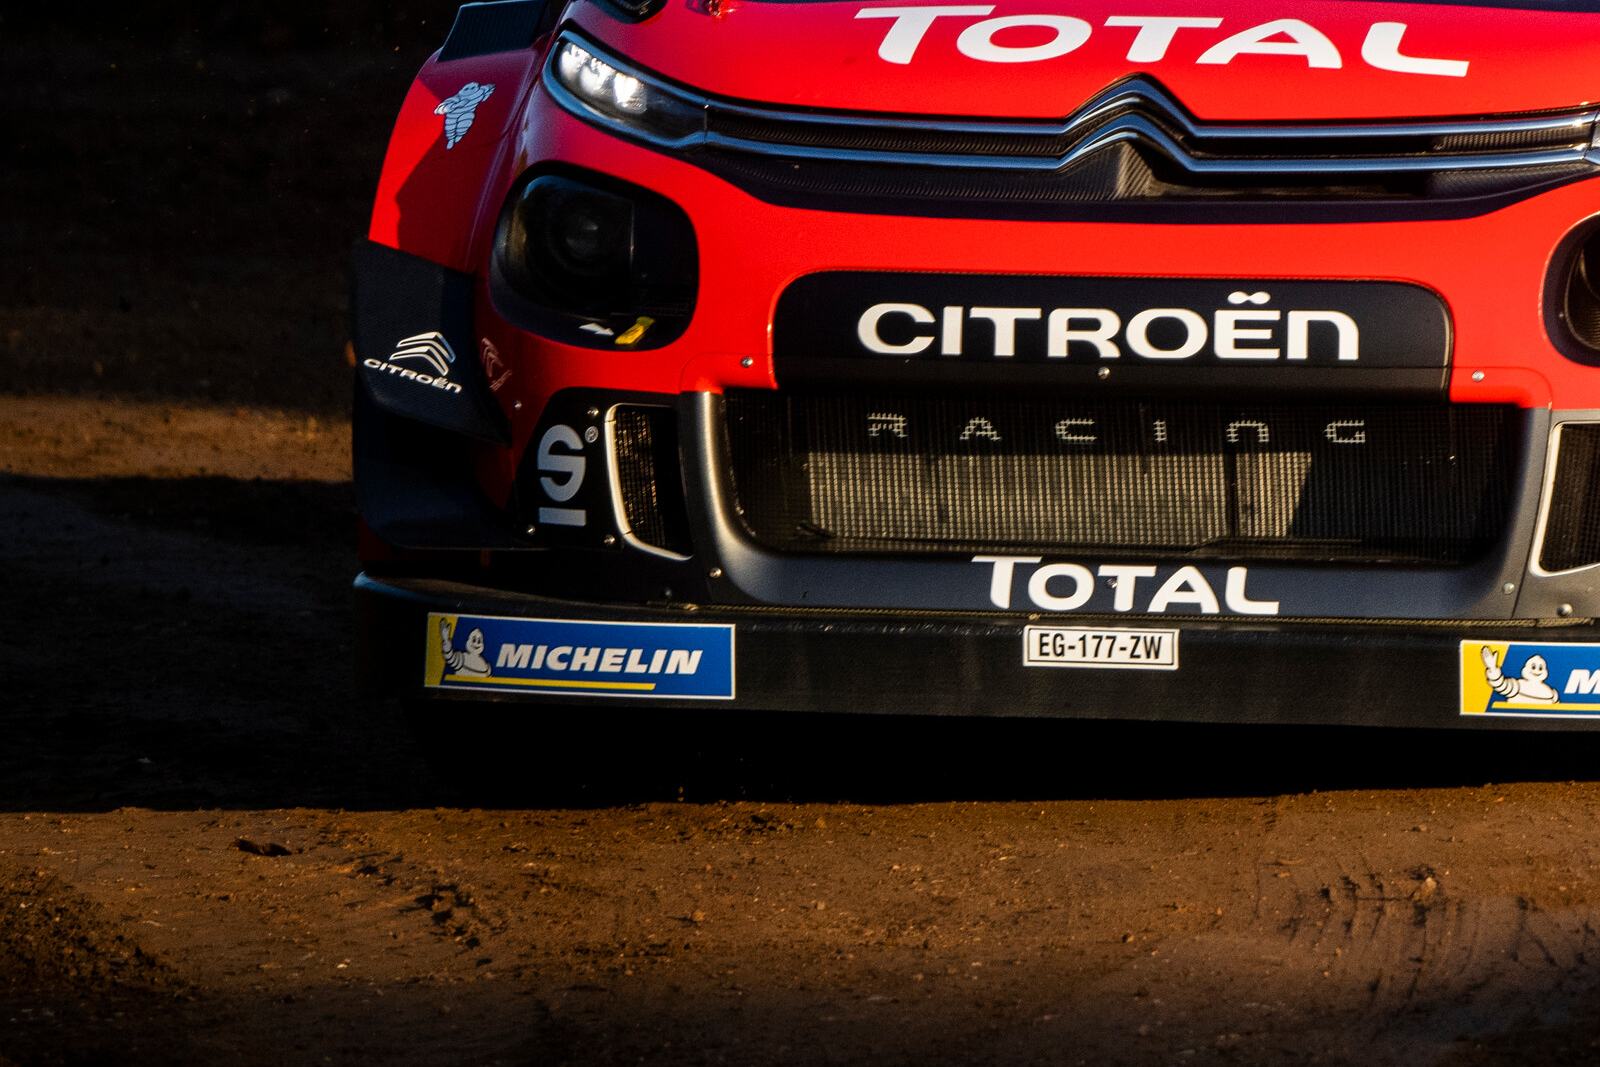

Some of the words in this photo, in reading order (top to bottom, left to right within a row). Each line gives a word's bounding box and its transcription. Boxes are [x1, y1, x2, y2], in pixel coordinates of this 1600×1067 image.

[854, 5, 1470, 78] TOTAL
[857, 290, 1359, 361] CITROËN
[363, 358, 463, 394] CITROËN
[971, 555, 1280, 615] TOTAL
[496, 641, 704, 676] MICHELIN
[1038, 632, 1164, 662] EG-177-ZW
